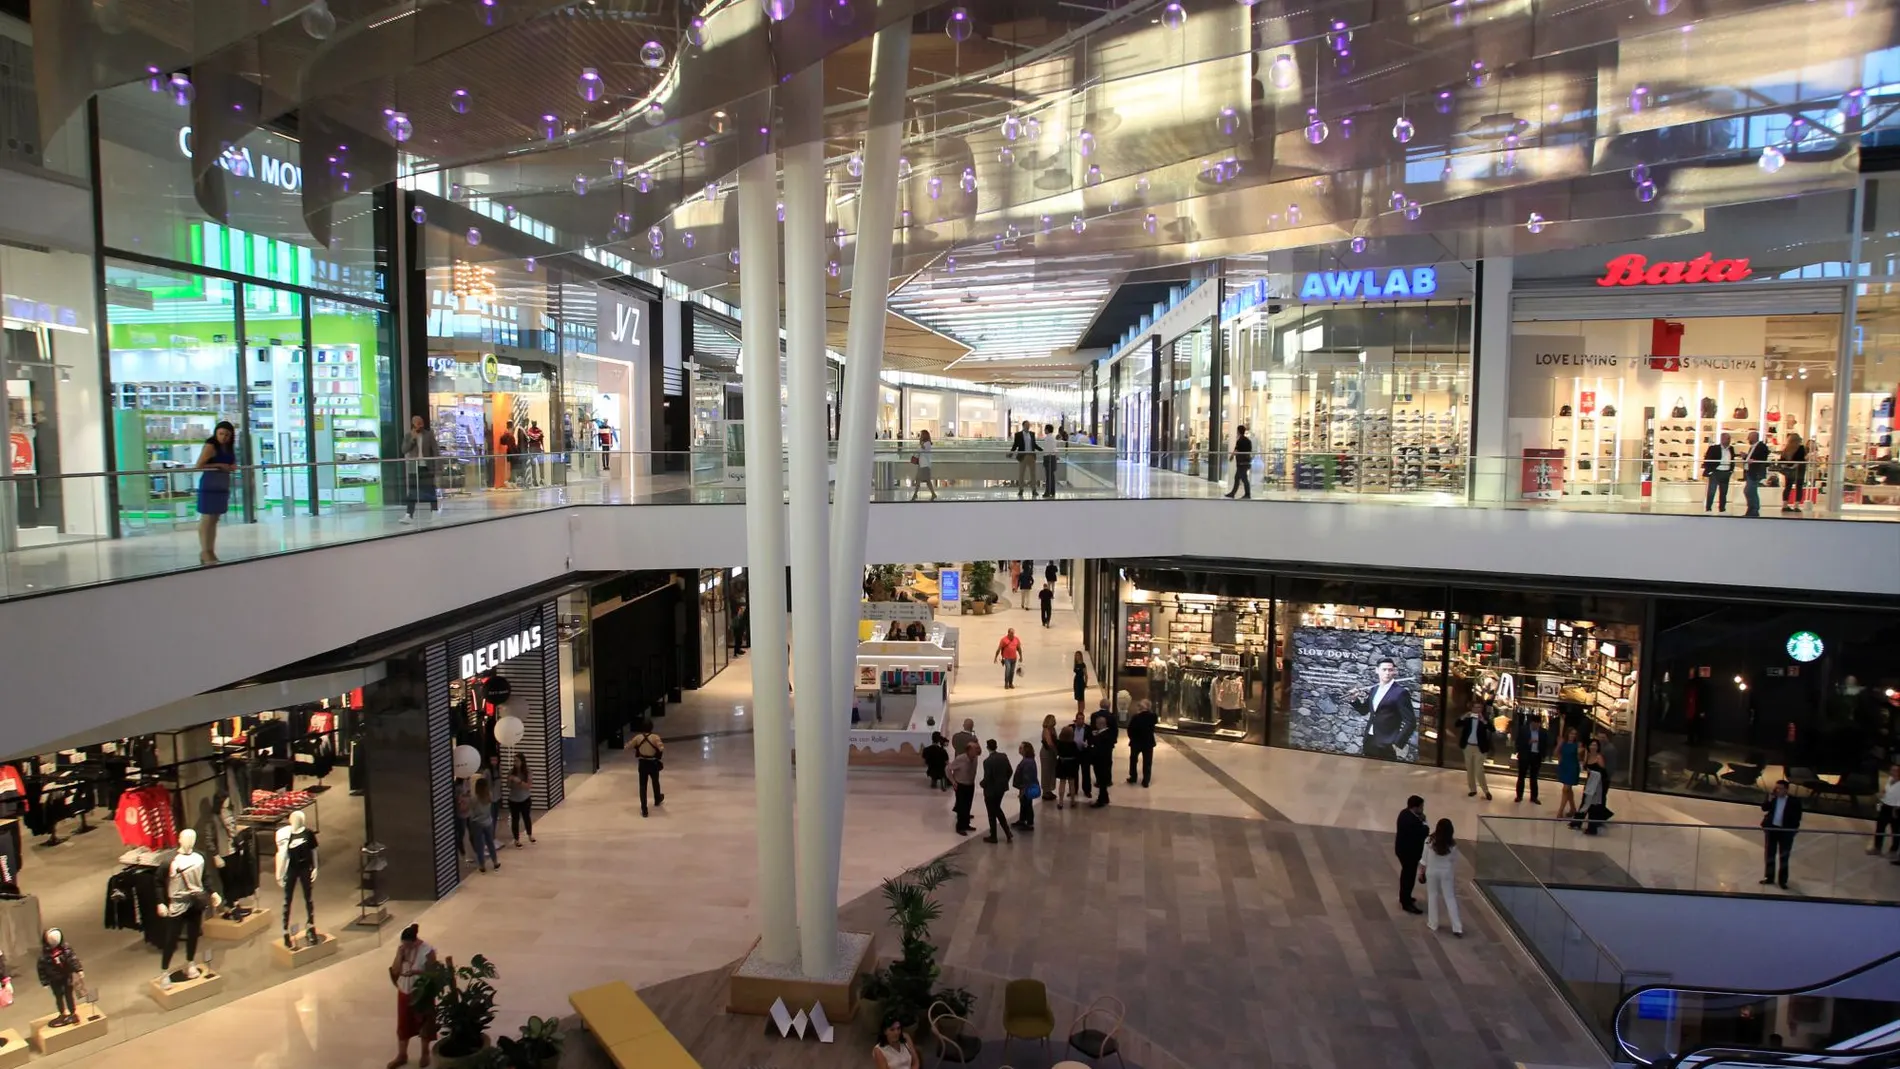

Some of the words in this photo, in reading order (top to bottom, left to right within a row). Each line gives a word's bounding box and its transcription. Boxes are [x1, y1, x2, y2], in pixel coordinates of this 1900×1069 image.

[1301, 266, 1436, 298] AWLAB
[1596, 251, 1752, 286] Bata
[1536, 353, 1569, 365] LOVE
[460, 625, 541, 680] DECIMAS
[1298, 647, 1325, 657] SLOW
[1328, 649, 1358, 660] DOWN
